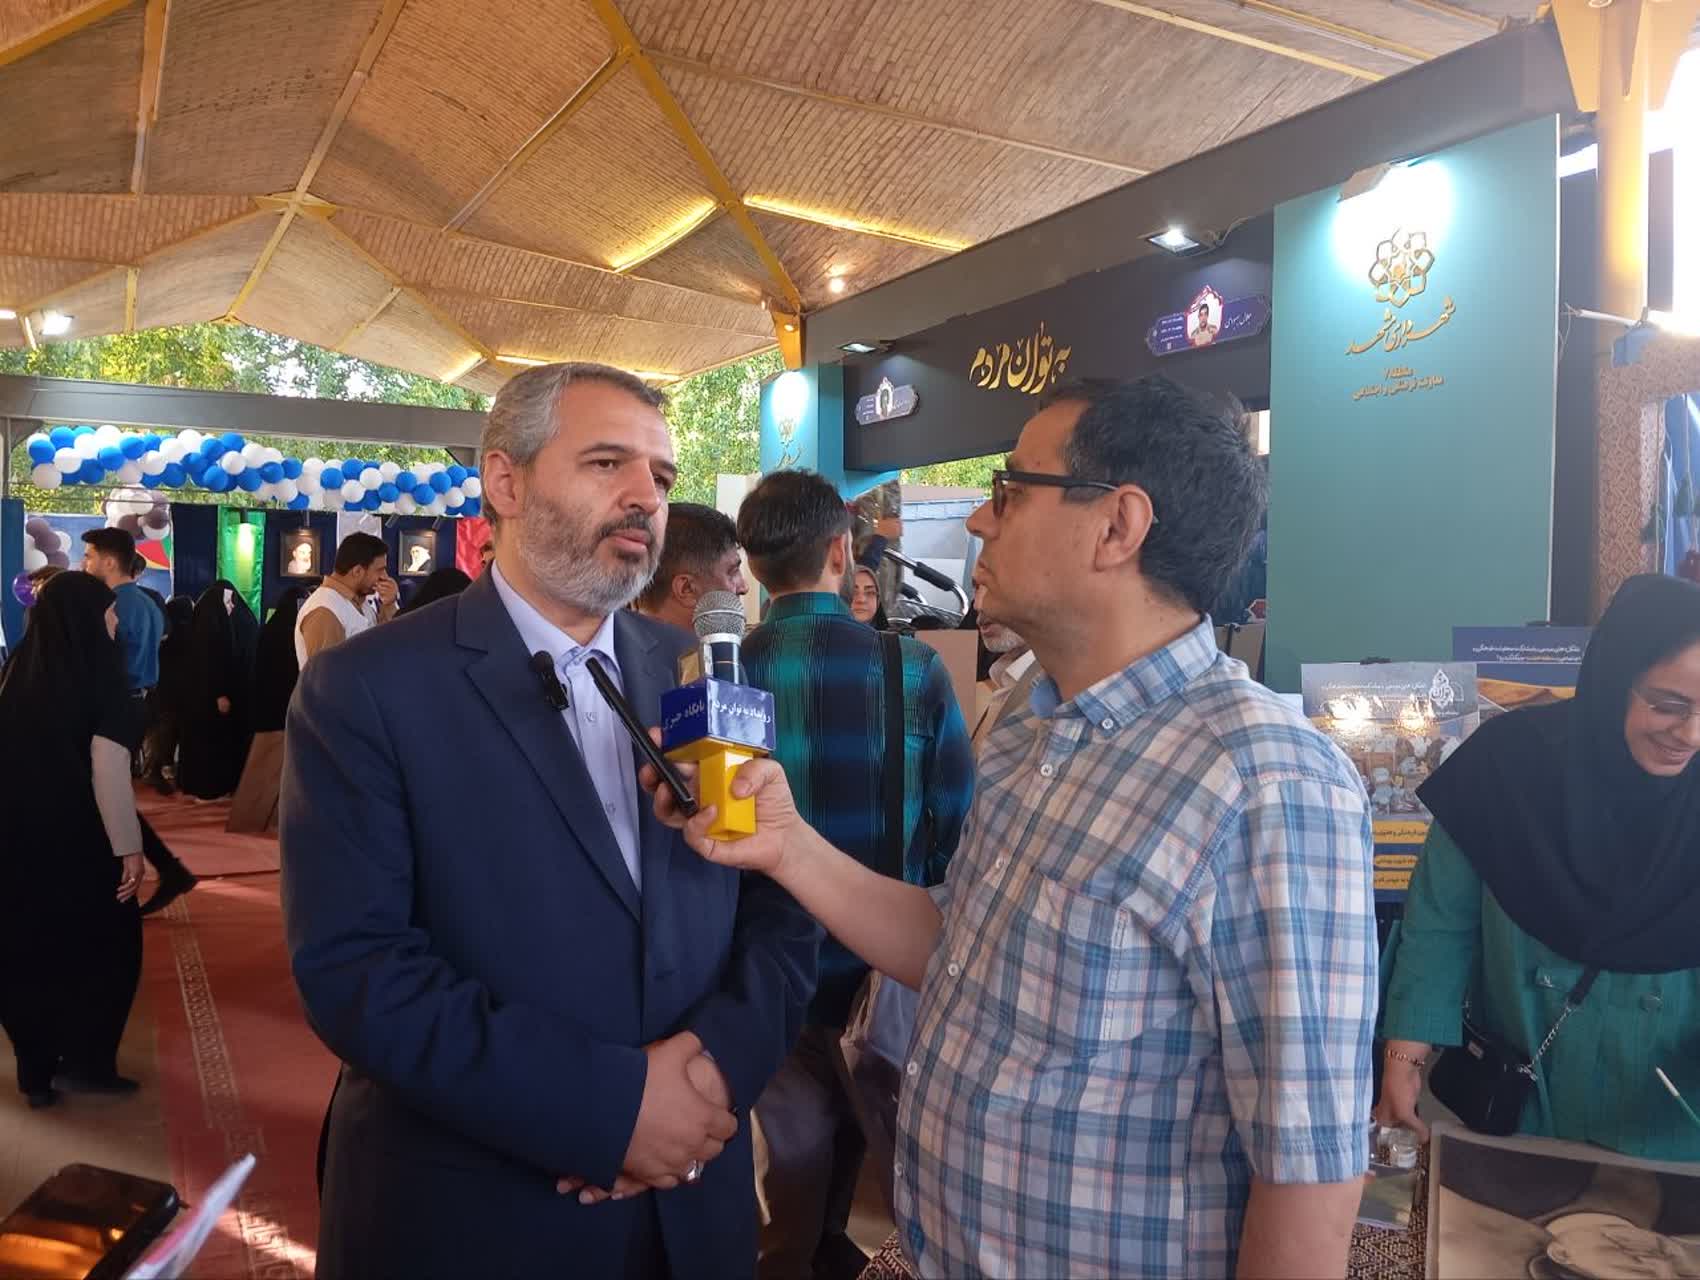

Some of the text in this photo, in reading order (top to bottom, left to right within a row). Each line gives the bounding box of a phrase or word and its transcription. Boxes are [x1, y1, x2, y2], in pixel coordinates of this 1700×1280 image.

[968, 319, 1073, 395] به توان مردم
[1344, 296, 1457, 356] شهرداری مشهد
